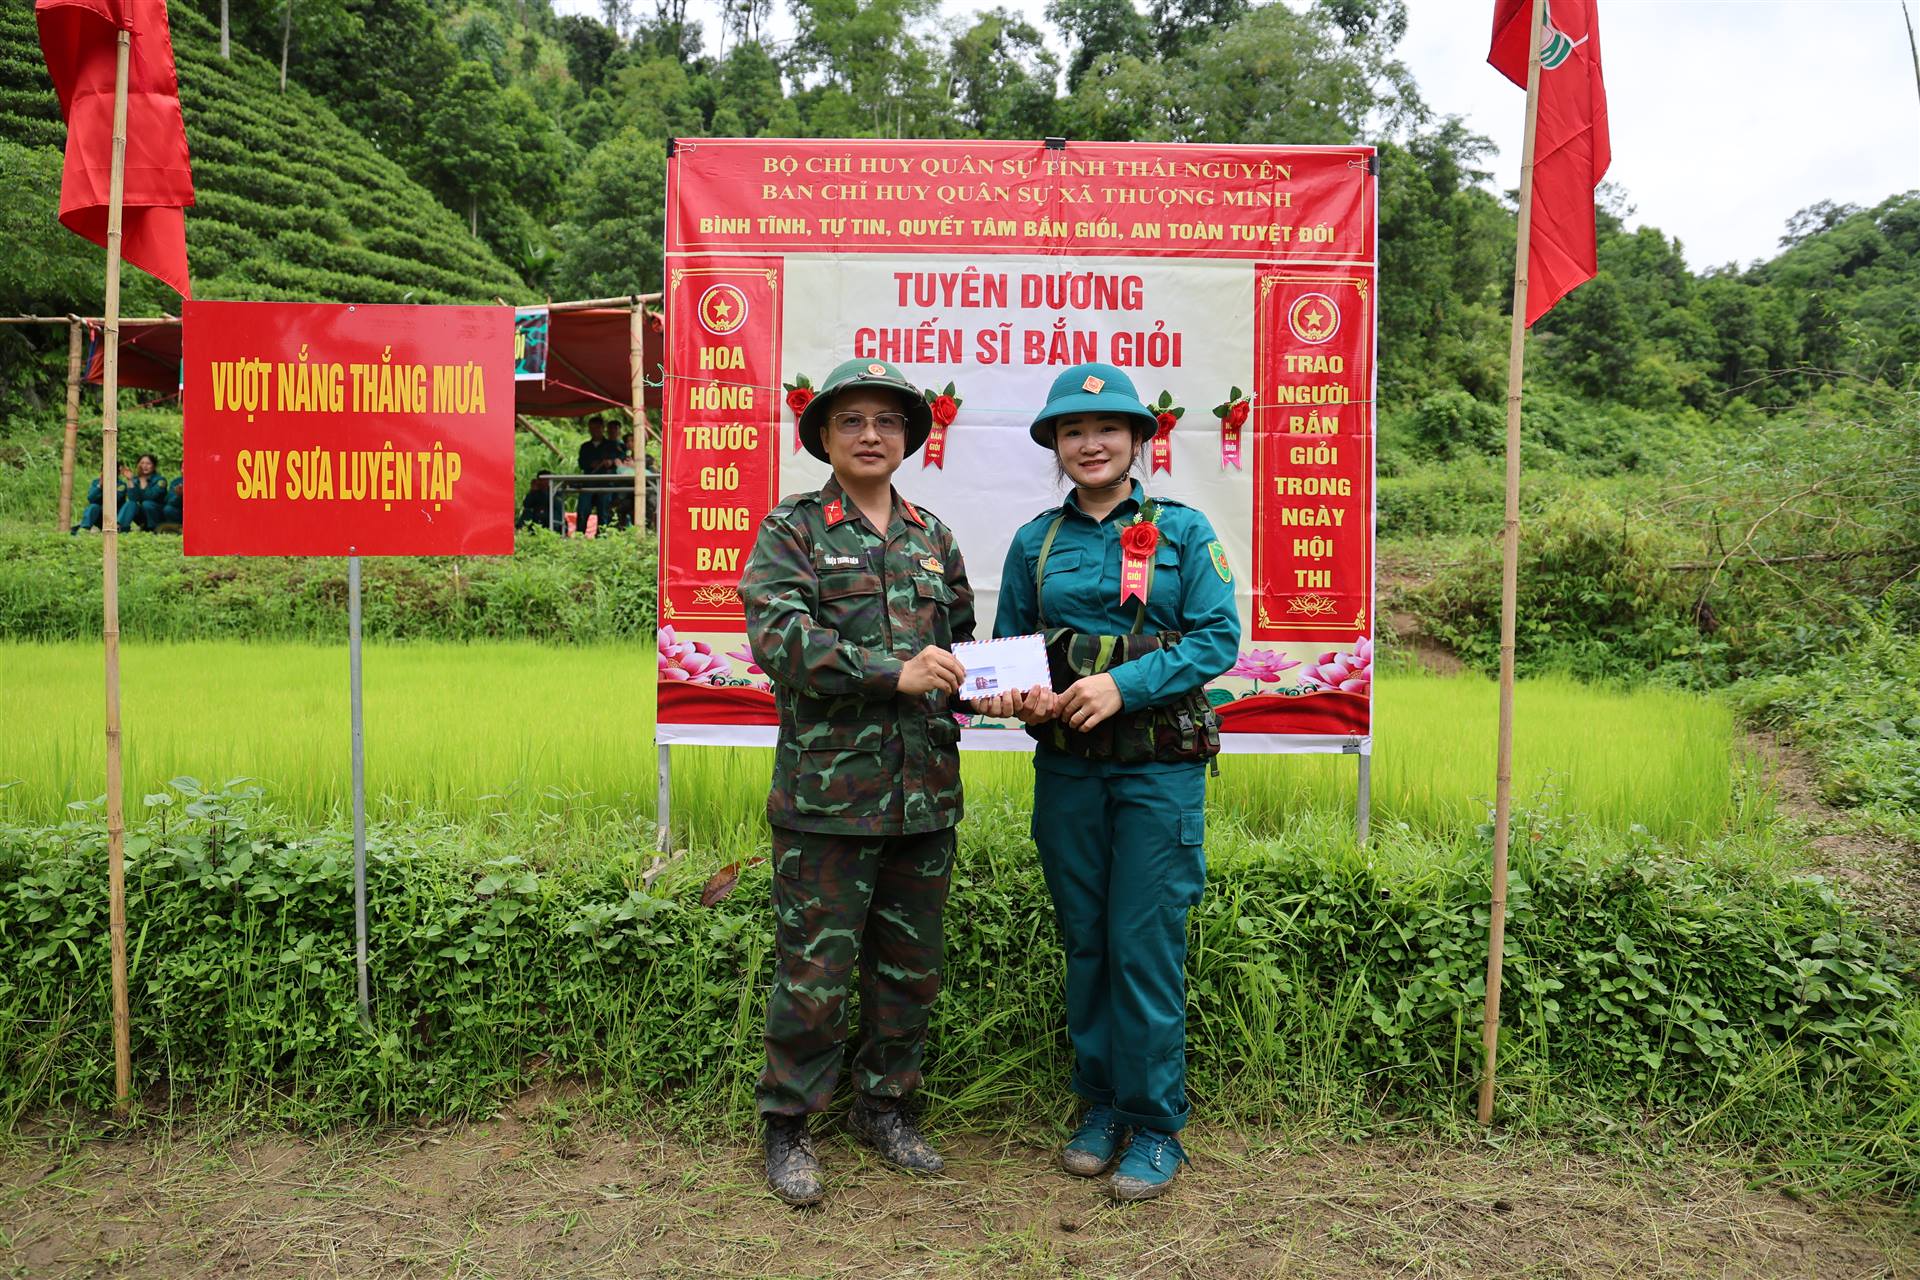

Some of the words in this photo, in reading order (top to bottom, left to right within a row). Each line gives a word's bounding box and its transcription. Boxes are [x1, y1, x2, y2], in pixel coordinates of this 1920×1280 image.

[764, 156, 799, 178] BỘ
[805, 153, 852, 174] CHỈ
[861, 158, 914, 174] HUY
[921, 154, 995, 177] QUÂN
[1002, 157, 1038, 179] SỰ
[1042, 157, 1105, 176] TỈNH
[1114, 158, 1176, 177] THÁI
[1185, 160, 1291, 180] NGUYÊN
[763, 184, 813, 200] BAN
[820, 181, 867, 200] CHỈ
[876, 184, 931, 200] HUY
[937, 182, 1010, 204] QUÂN
[1018, 185, 1053, 206] SỰ
[1060, 184, 1093, 203] XÃ
[1102, 187, 1215, 208] THƯỢNG
[1223, 191, 1291, 208] MINH
[700, 216, 750, 233] BÌNH
[758, 216, 811, 235] TĨNH,
[819, 218, 846, 237] TỰ
[851, 219, 890, 235] TIN,
[899, 217, 964, 236] QUYẾT
[972, 218, 1016, 236] TÂM
[1024, 216, 1067, 237] BẮN
[1075, 218, 1123, 239] GIỎI,
[1131, 224, 1160, 238] AN
[1168, 222, 1223, 239] TOÀN
[1231, 224, 1292, 244] TUYỆT
[1299, 224, 1333, 242] ĐỐI
[895, 266, 1007, 308] TUYÊN
[1021, 272, 1143, 310] DƯƠNG
[855, 318, 963, 364] CHIẾN
[976, 323, 1010, 364] SĨ
[1024, 317, 1097, 365] BẮN
[1111, 320, 1181, 367] GIỎI
[700, 347, 745, 369] HOA
[1285, 356, 1343, 373] TRAO
[212, 358, 271, 422] VƯỢT
[278, 344, 343, 412] NẮNG
[350, 346, 426, 413] THẮNG
[433, 361, 485, 414] MƯA
[691, 380, 752, 410] HỒNG
[1278, 383, 1348, 405] NGƯỜI
[1290, 410, 1338, 434] BẮN
[684, 423, 757, 450] TRƯỚC
[1291, 442, 1337, 464] GIỎI
[237, 450, 279, 499] SAY
[286, 446, 333, 499] SƯA
[340, 441, 411, 511] LUYỆN
[418, 442, 461, 511] TẬP
[701, 463, 738, 490] GIÓ
[1275, 478, 1350, 496] TRONG
[688, 508, 749, 530] TUNG
[1282, 506, 1344, 526] NGÀY
[697, 548, 740, 571] BAY
[1294, 536, 1332, 560] HỘI
[1127, 558, 1143, 569] BẮN
[1127, 571, 1142, 581] GIỎI
[1295, 570, 1330, 587] THI
